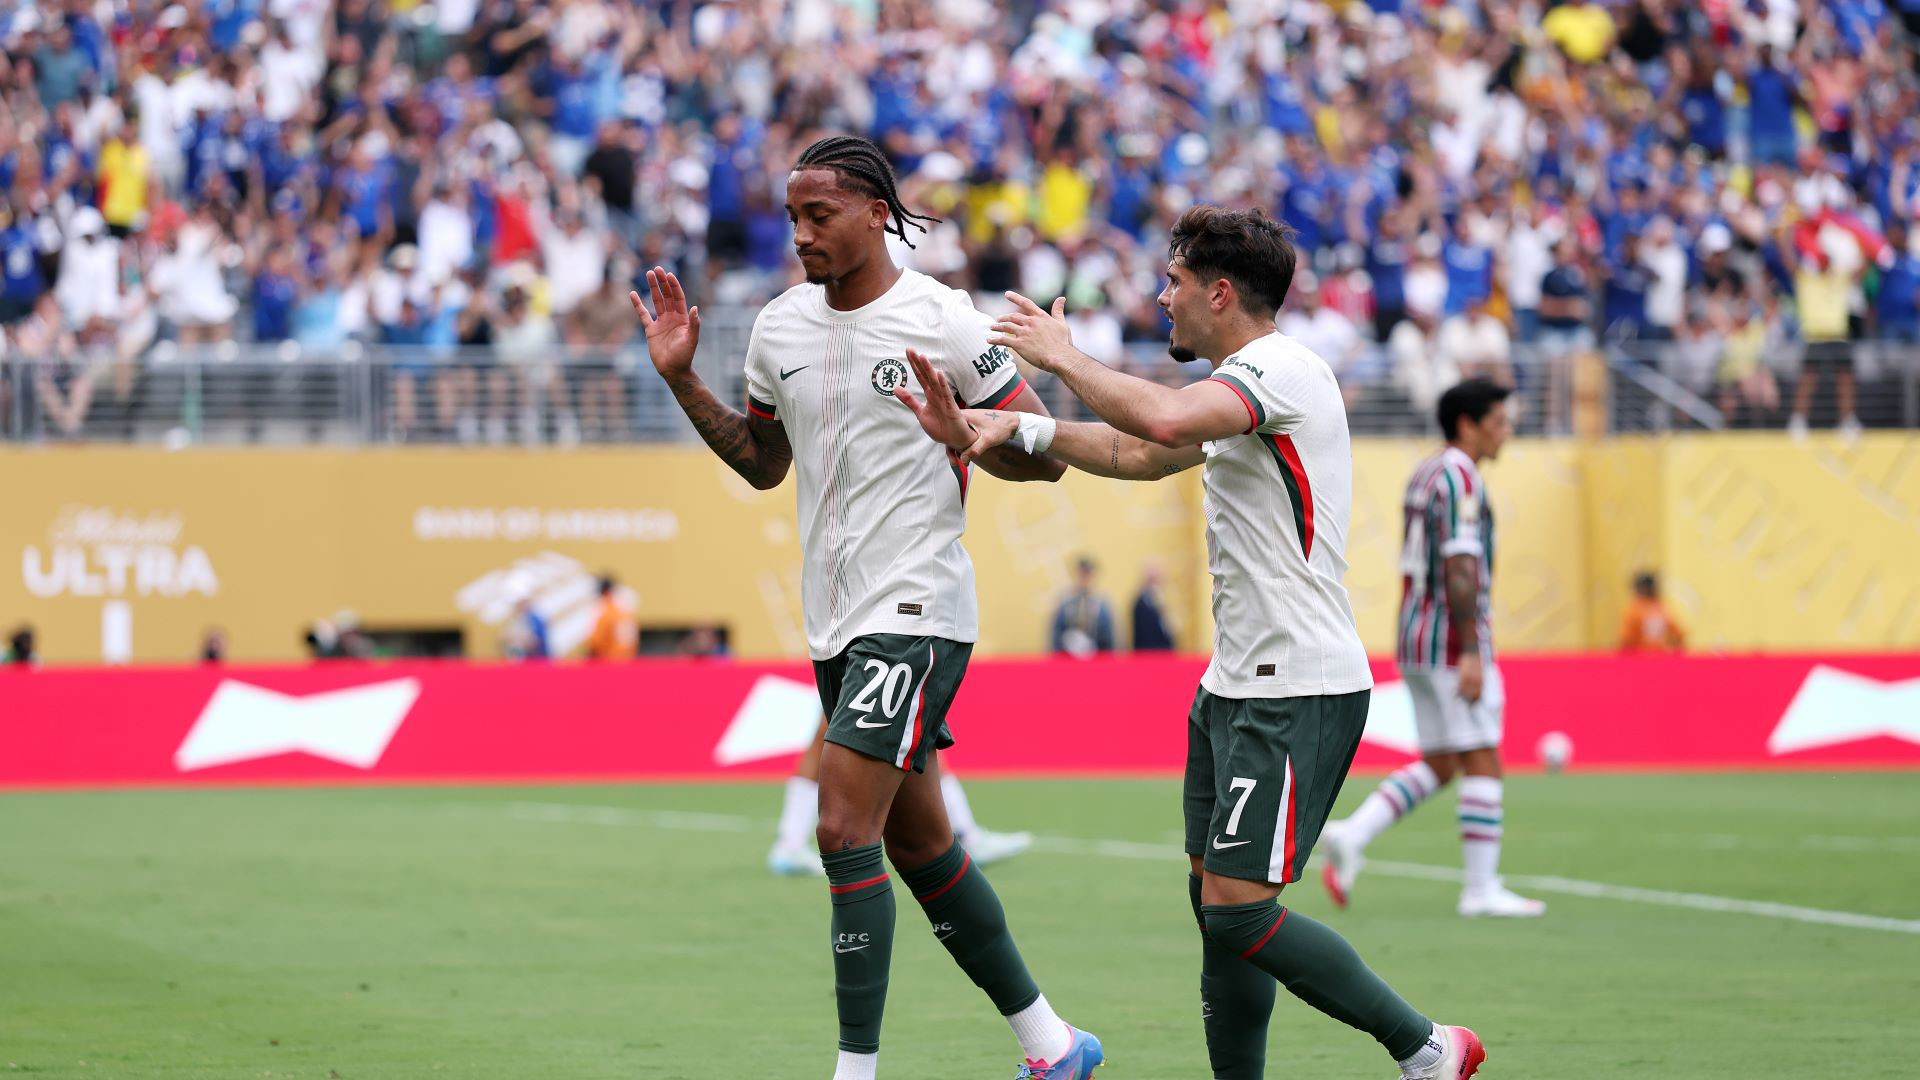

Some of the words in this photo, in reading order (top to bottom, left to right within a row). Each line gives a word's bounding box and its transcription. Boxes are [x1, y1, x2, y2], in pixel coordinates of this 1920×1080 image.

[878, 359, 903, 369] CHELSEA
[972, 345, 1001, 370] LIVE
[414, 506, 497, 541] BANK
[502, 506, 541, 541] OF
[547, 507, 678, 543] AMERICA
[22, 544, 219, 598] ULTRA
[848, 659, 912, 719] 20
[1225, 776, 1257, 836] 7
[838, 932, 870, 943] CFC
